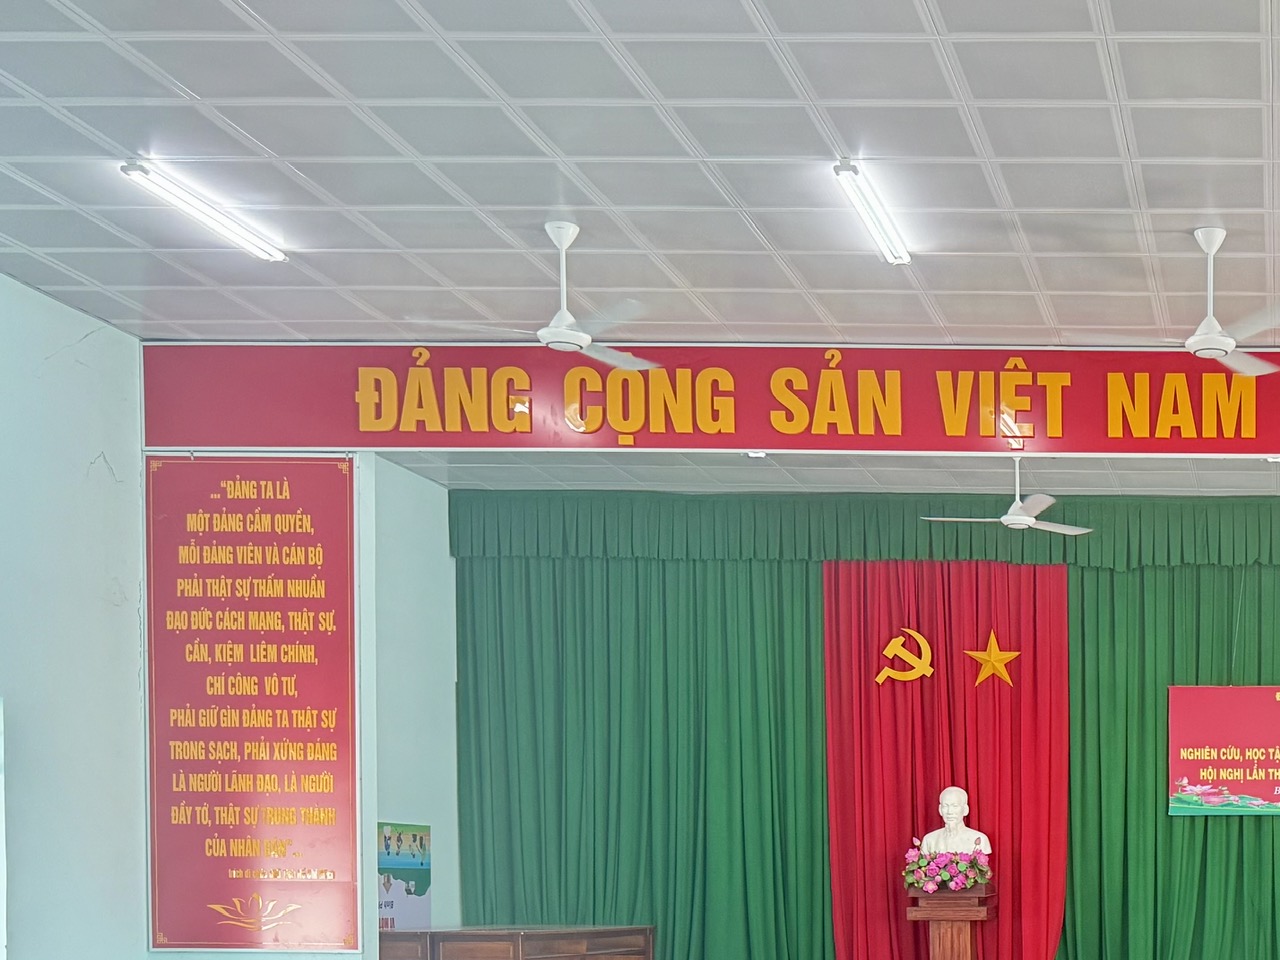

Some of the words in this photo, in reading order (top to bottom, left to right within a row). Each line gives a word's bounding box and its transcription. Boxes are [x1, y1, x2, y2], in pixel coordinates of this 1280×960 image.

[355, 348, 532, 433] ĐẢNG
[564, 353, 734, 445] CỘNG
[770, 348, 901, 435] SẢN
[936, 357, 1071, 448] VIỆT
[1107, 372, 1256, 438] NAM
[260, 481, 274, 499] TA
[276, 477, 290, 499] LÀ
[187, 509, 210, 536] MỘT
[213, 507, 243, 532] ĐẢNG
[247, 507, 271, 532] CẦM
[275, 508, 314, 535] QUYỀN,
[179, 539, 200, 564] MỖI
[203, 540, 233, 564] ĐẢNG
[236, 543, 262, 564] VIÊN
[265, 543, 279, 564] VÀ
[283, 543, 305, 565] CÁN
[308, 544, 323, 569] BỘ
[177, 573, 202, 596] PHẢI
[206, 575, 232, 600] THẬT
[236, 577, 251, 600] SỰ
[253, 573, 283, 597] THẤM
[288, 574, 325, 598] NHUẦN
[166, 611, 188, 634] ĐẠO
[191, 607, 213, 630] ĐỨC
[216, 607, 244, 630] CÁCH
[249, 611, 285, 634] MẠNG,
[288, 609, 314, 635] THẬT
[185, 638, 211, 664] CẦN,
[215, 641, 243, 666] KIỆM
[250, 641, 277, 662] LIÊM
[281, 641, 318, 665] CHÍNH,
[206, 672, 225, 695] CHÍ
[228, 673, 258, 695] CÔNG
[264, 673, 278, 695] VÔ
[281, 674, 297, 698] TƯ,
[170, 704, 195, 727] PHẢI
[199, 705, 218, 727] GIỮ
[220, 705, 239, 727] GÌN
[242, 704, 272, 728] ĐẢNG
[276, 710, 289, 728] TA
[292, 707, 318, 732] THẬT
[321, 708, 337, 732] SỰ
[169, 741, 205, 759] TRONG
[209, 741, 240, 764] SẠCH,
[244, 736, 269, 760] PHẢI
[273, 738, 304, 760] XỨNG
[307, 738, 337, 761] ĐÁNG
[1180, 746, 1217, 760] NGHIÊN
[1220, 745, 1242, 762] CỨU,
[1246, 748, 1265, 763] HỌC
[172, 770, 186, 792] LÀ
[189, 770, 221, 792] NGƯỜI
[225, 770, 253, 792] LÃNH
[256, 774, 280, 796] ĐẠO,
[285, 771, 297, 792] LÀ
[301, 771, 333, 792] NGƯỜI
[1200, 766, 1216, 782] HỘI
[1220, 768, 1243, 783] NGHỊ
[171, 801, 192, 824] ĐẦY
[195, 802, 211, 826] TỚ,
[214, 803, 240, 829] THẬT
[244, 805, 259, 828] SỰ
[205, 833, 227, 856] CỦA
[230, 835, 260, 856] NHÂN
